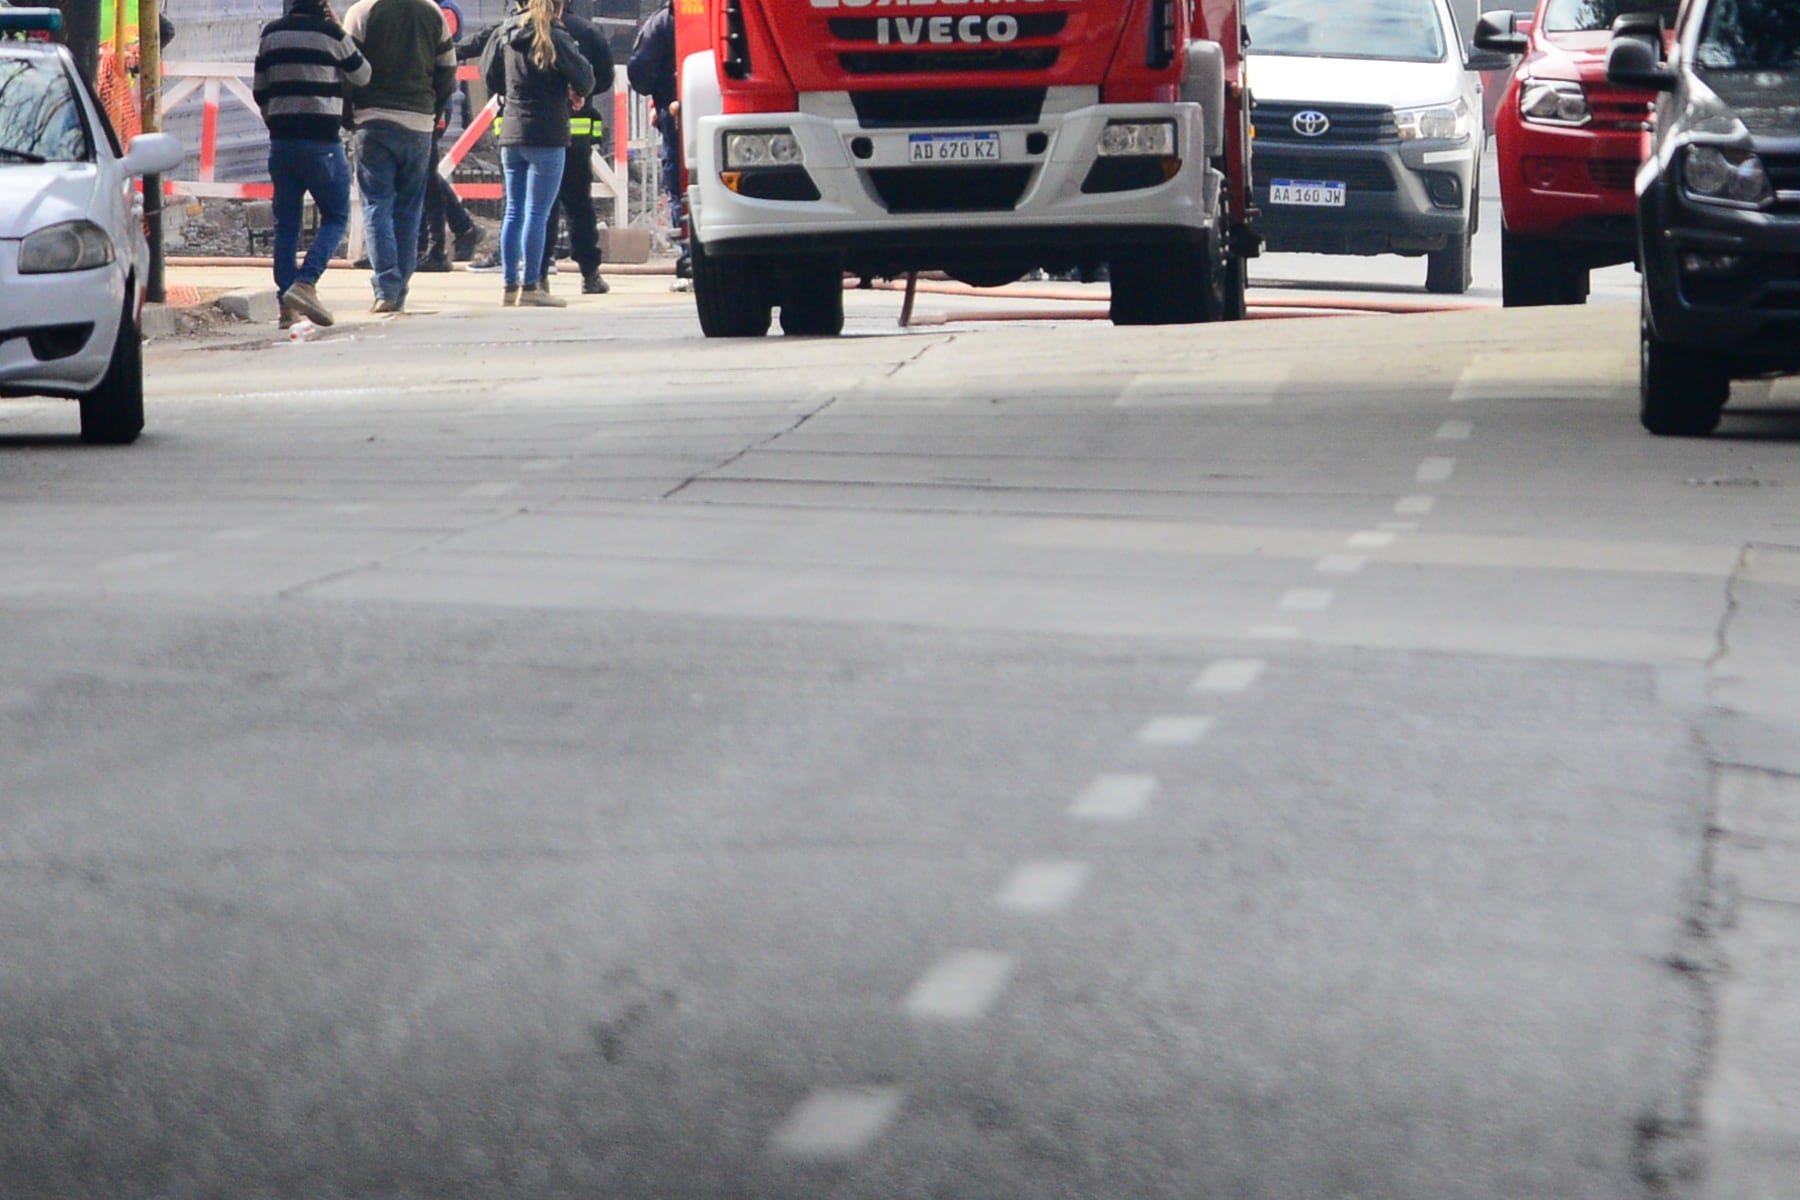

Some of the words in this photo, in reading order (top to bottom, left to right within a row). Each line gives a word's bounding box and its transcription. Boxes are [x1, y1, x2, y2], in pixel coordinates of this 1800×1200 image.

[876, 14, 1019, 45] IVECO
[913, 142, 934, 160] AD
[940, 141, 970, 159] 670
[974, 140, 996, 158] KZ
[1273, 187, 1290, 201] AA
[1295, 188, 1320, 203] 160
